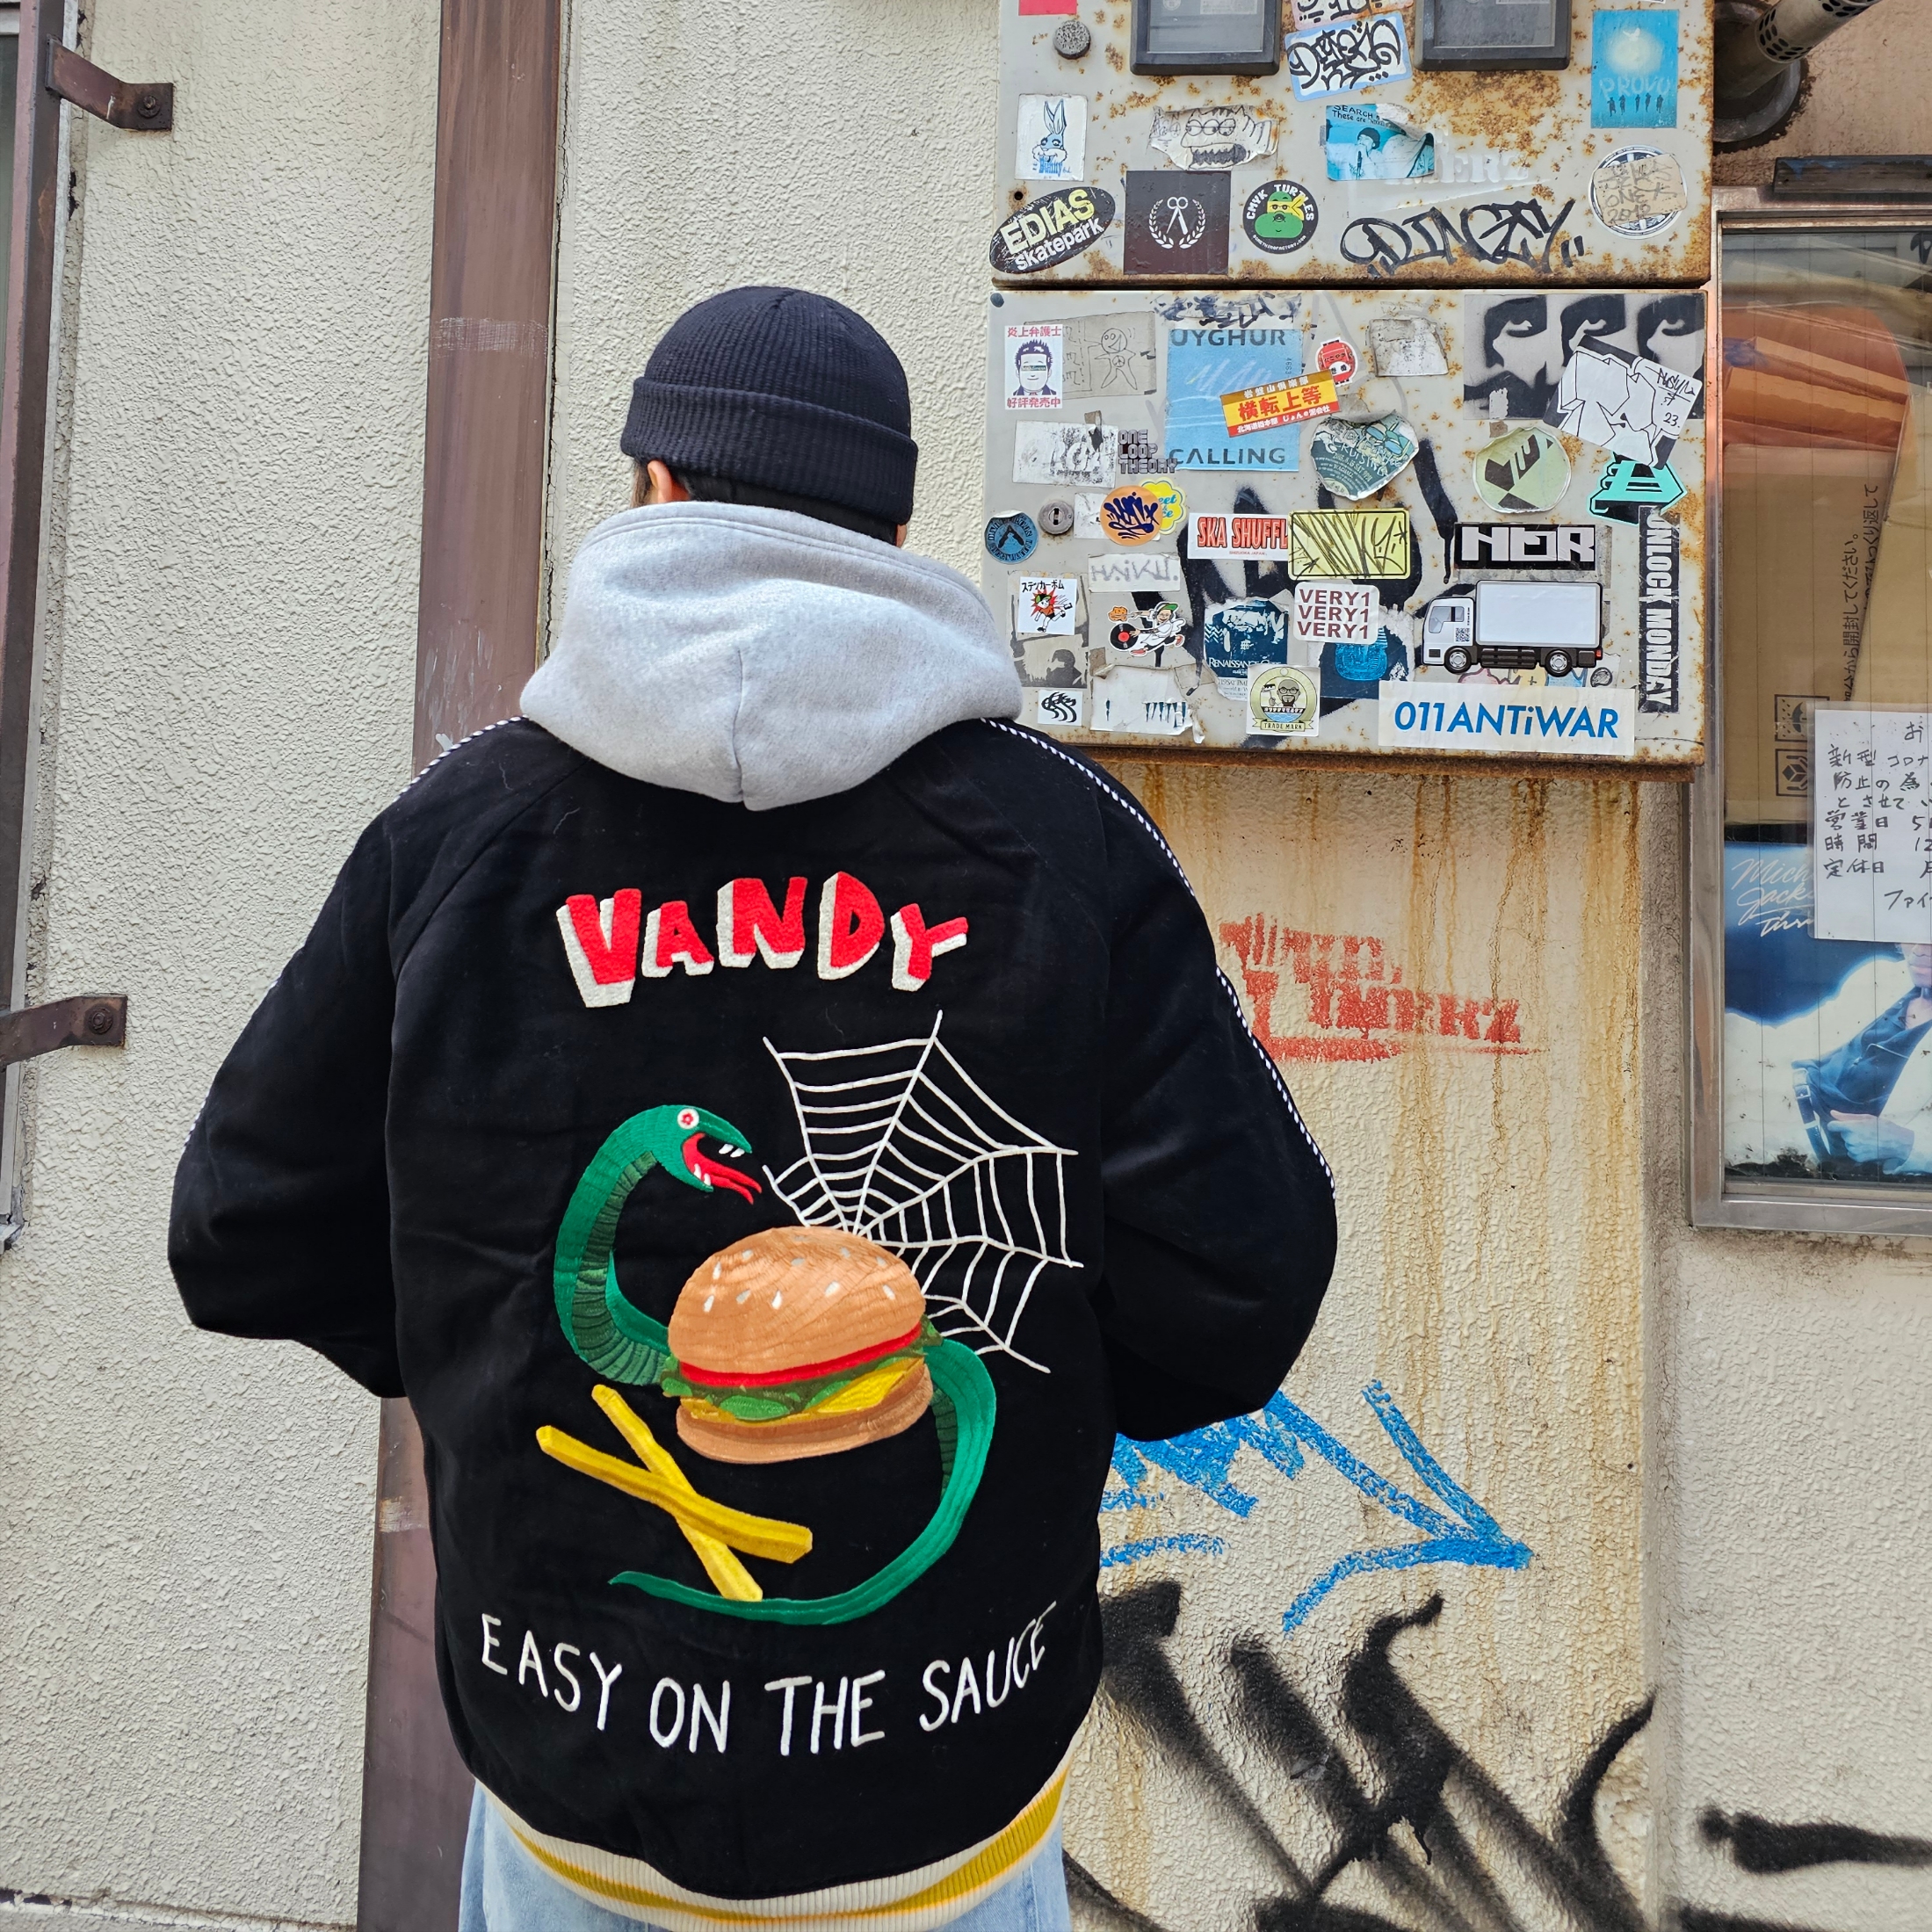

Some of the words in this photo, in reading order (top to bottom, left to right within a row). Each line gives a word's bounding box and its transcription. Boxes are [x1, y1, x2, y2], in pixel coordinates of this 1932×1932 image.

[1332, 110, 1353, 120] These
[1246, 189, 1269, 220] CMYK
[1000, 189, 1095, 255] EDIAS
[1015, 218, 1104, 271] skatepark
[1007, 326, 1062, 337] 炎上弁護士
[1237, 385, 1322, 422] 横転上等
[1118, 429, 1147, 445] ONE
[1118, 444, 1158, 459] LOOP
[1169, 448, 1285, 465] CALLING
[1118, 458, 1178, 474] THEORY
[1198, 517, 1227, 548] SKA
[1232, 517, 1288, 549] SHUFFL
[1299, 589, 1370, 607] VERY1
[1299, 604, 1369, 623] VERY1
[1297, 620, 1368, 640] VERY1
[1646, 608, 1672, 706] MONDAY
[1824, 832, 1878, 854] 時間
[1731, 857, 1813, 890] Mich
[1823, 857, 1885, 879] 定休日
[1736, 882, 1814, 926] Jack
[556, 872, 968, 1008] VANDY
[481, 1613, 622, 1731] EASY
[648, 1676, 730, 1754] ON
[764, 1669, 885, 1755] THE
[918, 1601, 1057, 1732] SAUCE
